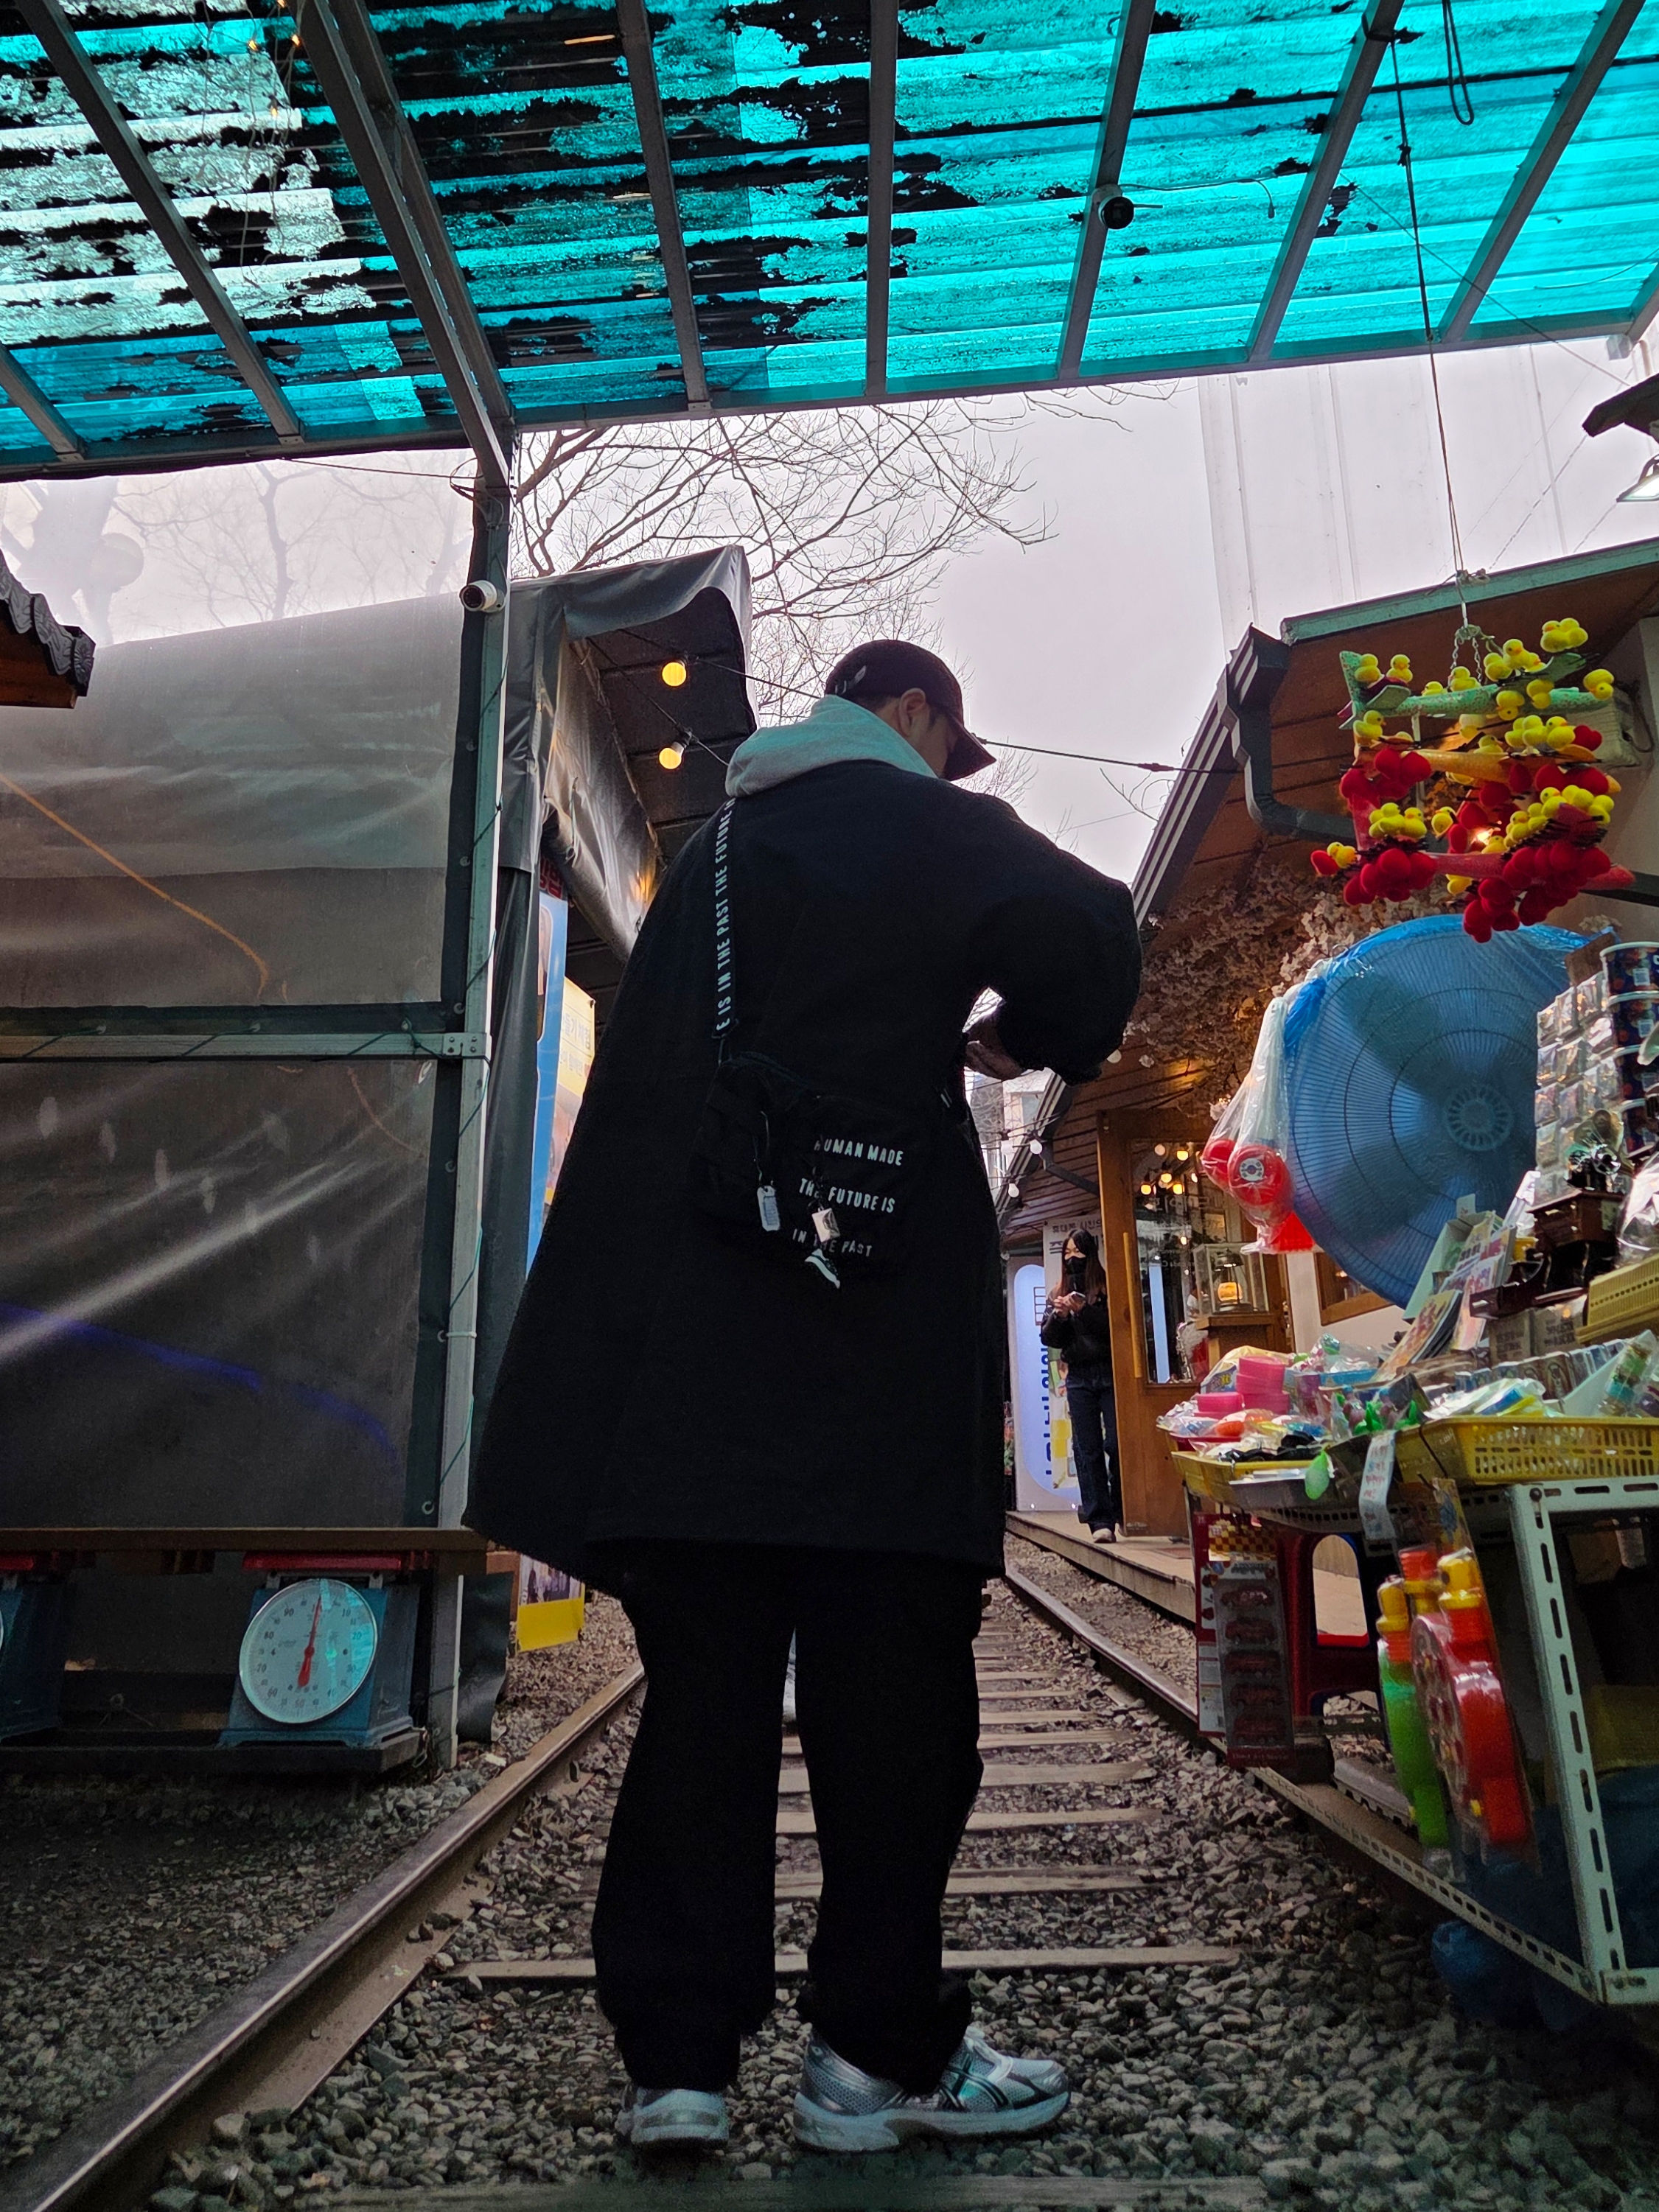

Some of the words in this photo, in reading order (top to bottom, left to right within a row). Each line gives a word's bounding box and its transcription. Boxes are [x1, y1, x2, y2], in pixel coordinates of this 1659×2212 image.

[715, 810, 733, 864] FUTURE
[715, 865, 728, 897] THE
[716, 898, 729, 937] PAST
[716, 938, 731, 970] THE
[717, 972, 732, 993] IN
[717, 996, 732, 1015] IS
[867, 1144, 904, 1166] MADE
[828, 1186, 879, 1211] FUTURE
[881, 1197, 895, 1214] IS
[792, 1228, 807, 1244] IN
[841, 1239, 873, 1257] PAST
[284, 1608, 294, 1617] 90
[342, 1609, 351, 1617] 10
